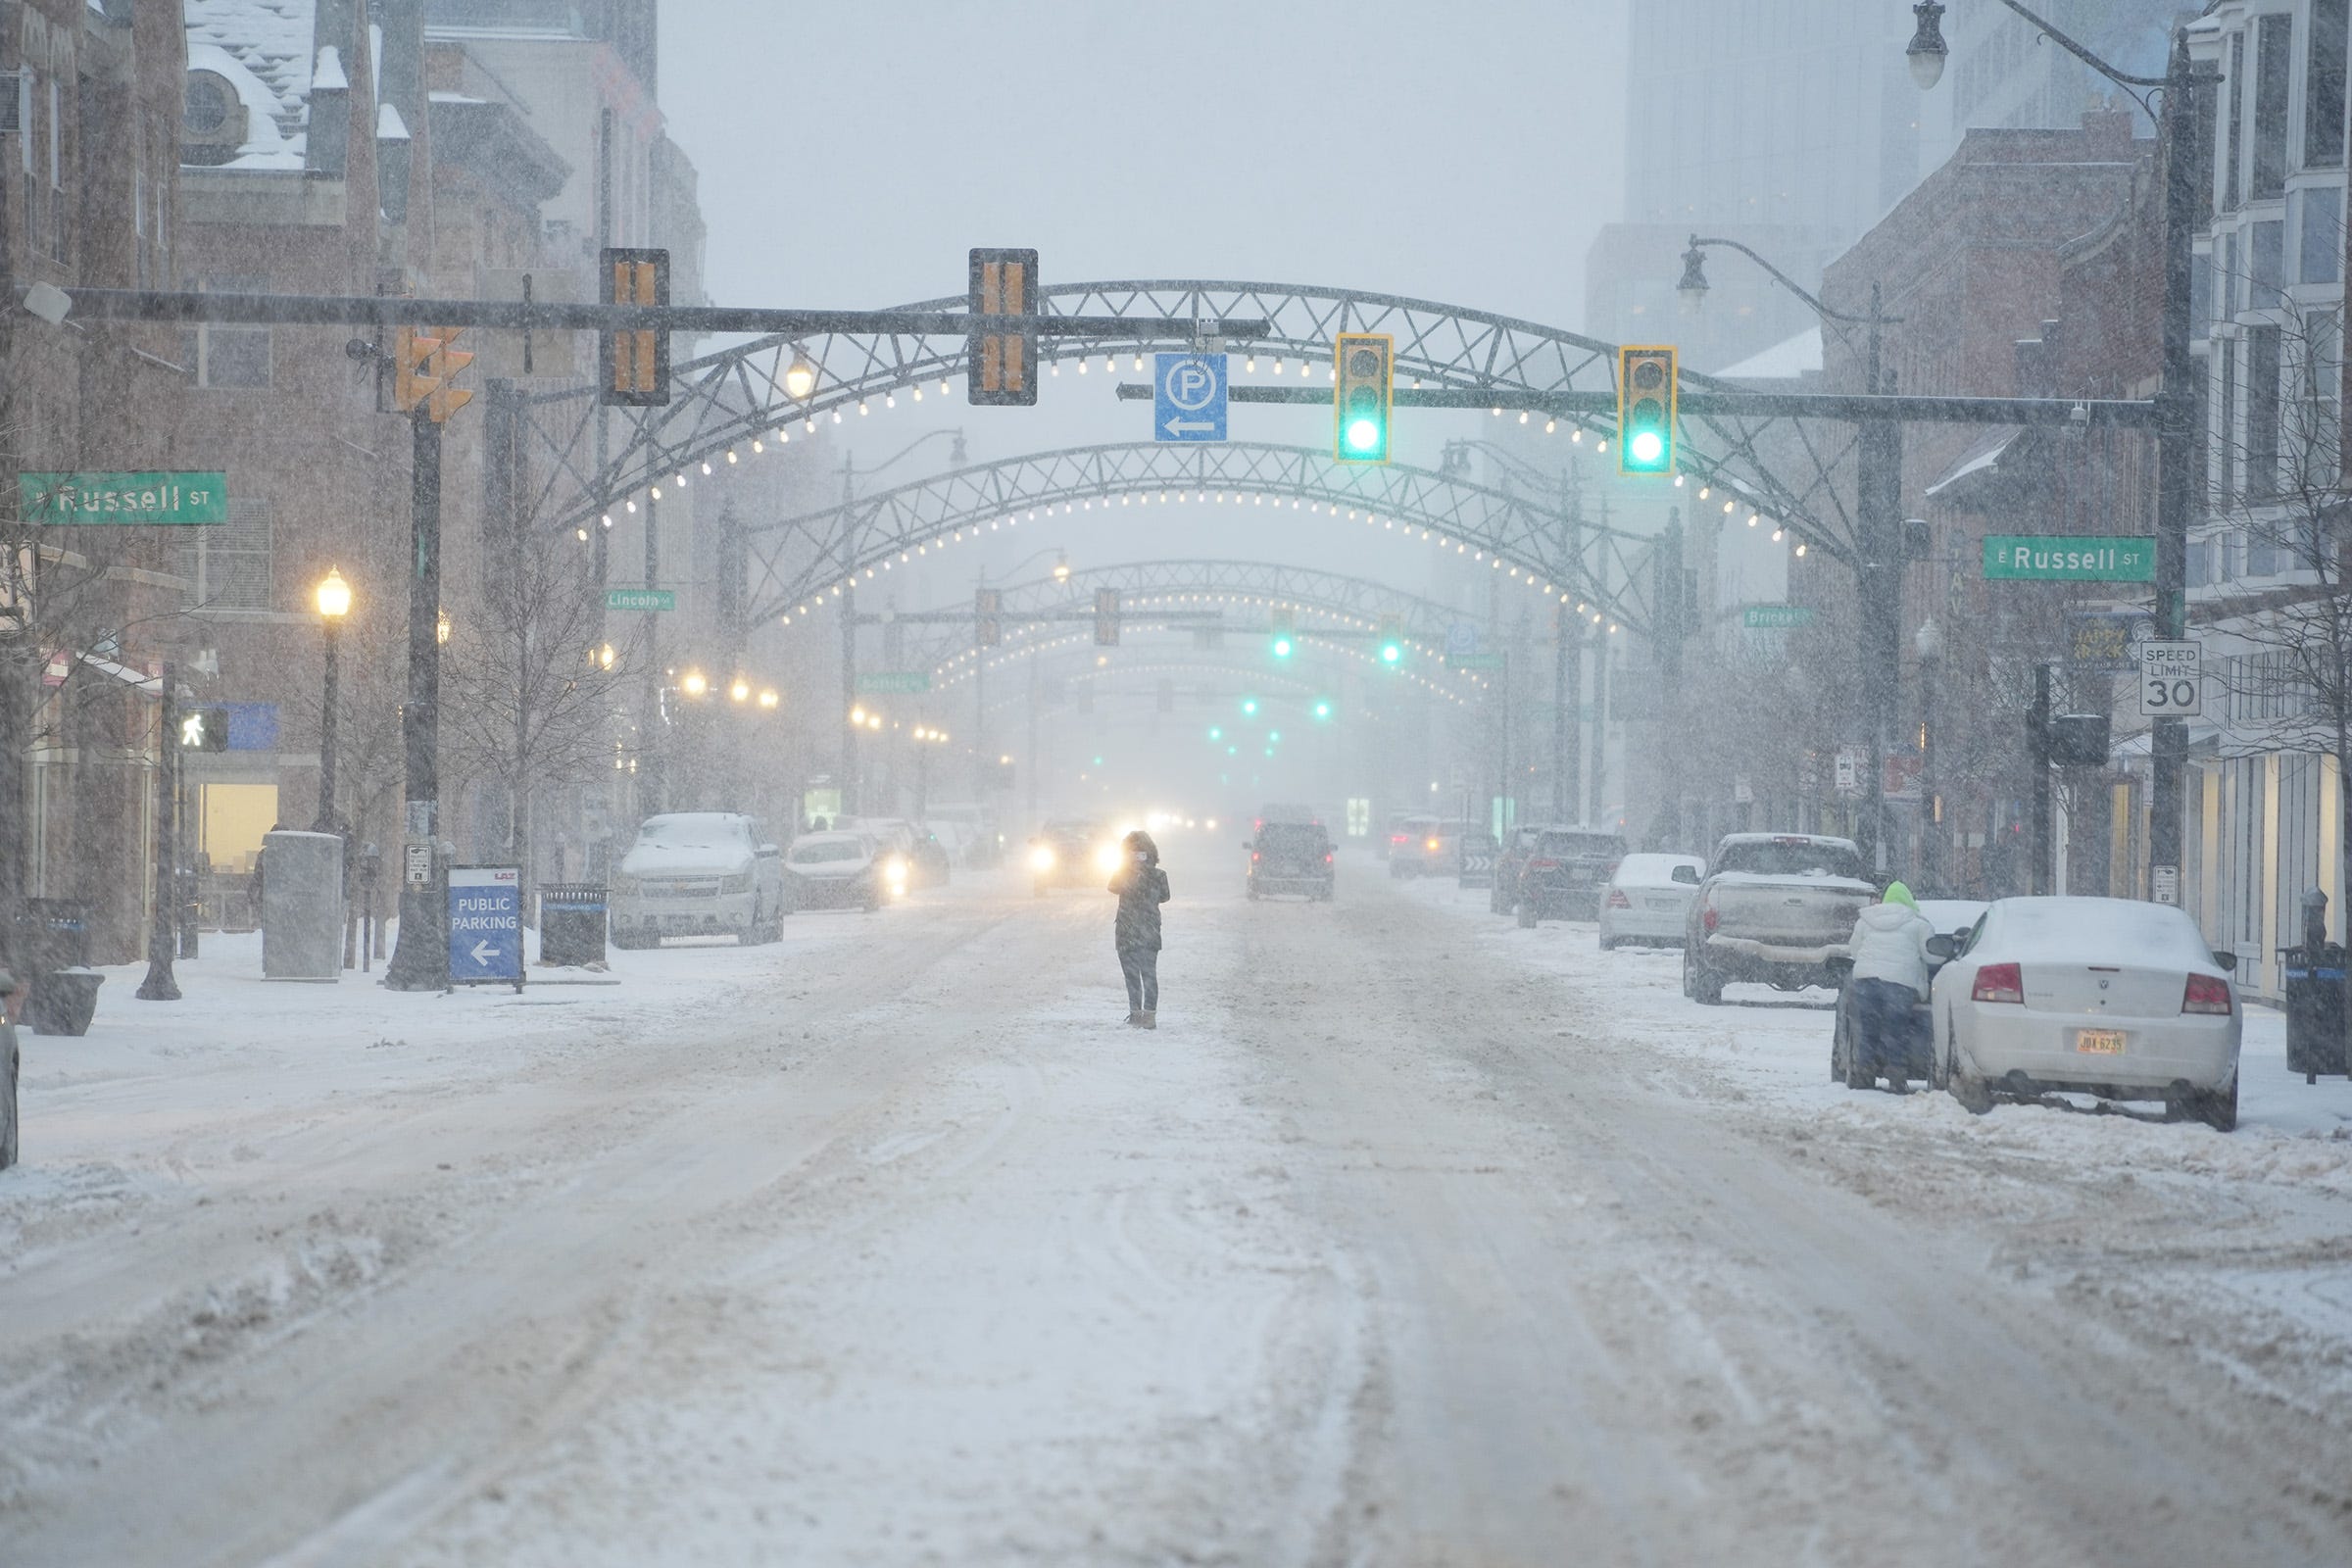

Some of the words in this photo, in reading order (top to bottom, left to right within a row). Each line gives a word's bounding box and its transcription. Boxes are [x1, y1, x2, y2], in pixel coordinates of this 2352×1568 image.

[59, 485, 179, 512] Russell
[190, 491, 210, 505] ST
[1998, 552, 2007, 564] E
[2015, 547, 2115, 569] Russell
[2124, 553, 2140, 564] ST
[608, 594, 659, 606] Lincoln
[2146, 650, 2196, 662] SPEED
[2151, 665, 2189, 677] LIMIT
[2146, 679, 2195, 708] 30
[459, 898, 511, 911] PUBLIC
[452, 916, 517, 930] PARKING
